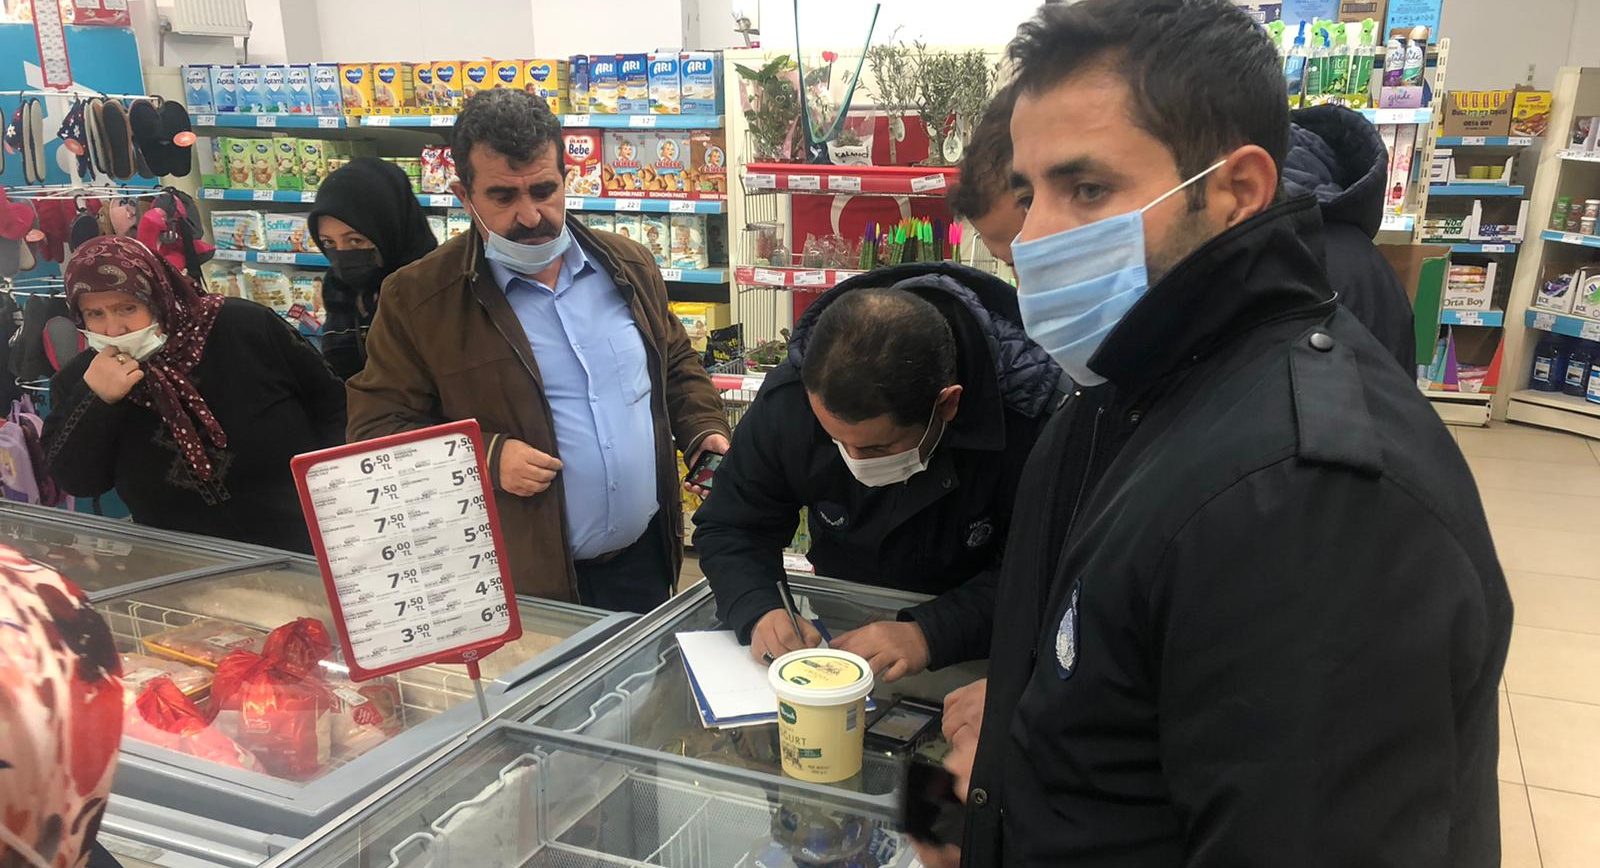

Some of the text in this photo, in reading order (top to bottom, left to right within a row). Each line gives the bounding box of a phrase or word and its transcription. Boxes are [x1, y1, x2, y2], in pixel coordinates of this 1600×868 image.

[595, 63, 613, 75] ARI
[622, 60, 640, 72] ARI
[654, 63, 672, 74] ARI
[687, 61, 706, 72] ARI
[187, 77, 206, 85] Aptamil
[237, 77, 257, 85] Aptamil
[264, 77, 284, 85] Aptamil
[287, 77, 307, 85] Aptamil
[1388, 91, 1410, 106] glade
[568, 144, 590, 155] Bebe
[1444, 297, 1485, 308] Orta Boy
